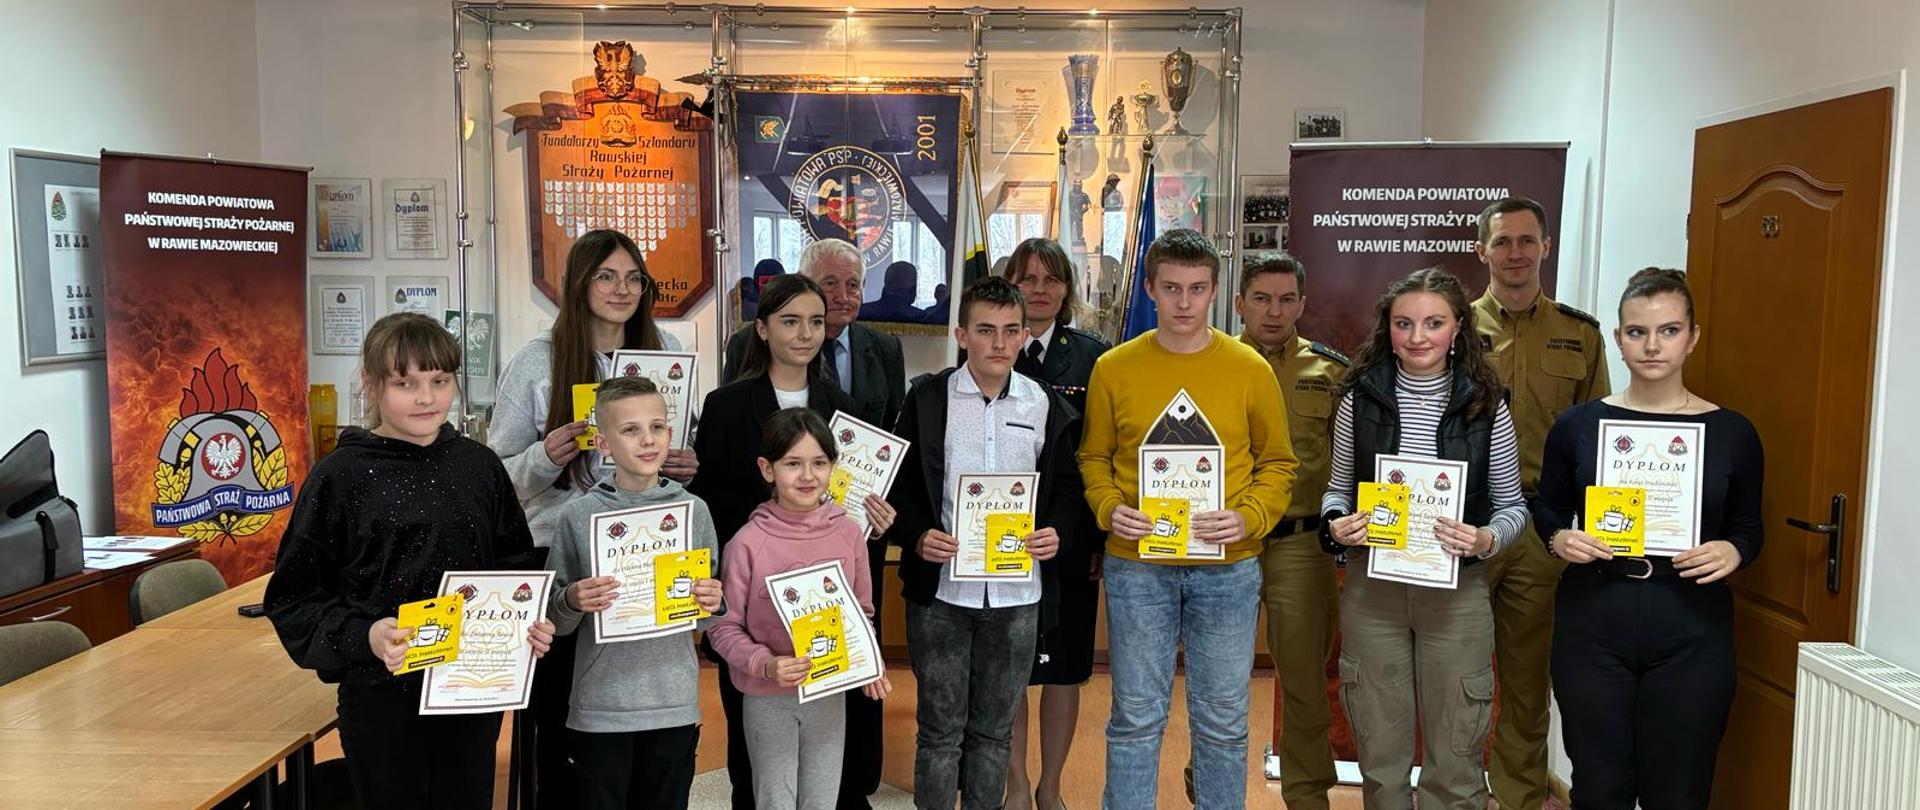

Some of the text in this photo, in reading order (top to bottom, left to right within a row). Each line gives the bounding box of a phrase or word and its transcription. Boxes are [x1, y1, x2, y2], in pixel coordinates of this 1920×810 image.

[638, 136, 696, 149] Sztandaru
[917, 115, 936, 161] 2001
[590, 151, 647, 163] Rawskiej
[562, 165, 674, 180] Straży Pożarnej
[148, 192, 275, 210] KOMENDA POWIATOWA
[1342, 187, 1509, 201] KOMENDA POWIATOWA
[395, 204, 429, 214] Dyplom
[124, 212, 294, 234] PAŃSTWOWEJ STRAŻY POŻARNEJ
[1313, 211, 1409, 229] PAŃSTWOWEJ
[1411, 212, 1465, 227] STRAŻY
[148, 238, 278, 254] W RAWIE MAZOWIECKIEJ
[1338, 240, 1475, 252] W RAWIE MAZOWIE
[840, 452, 885, 477] YPLOM
[1613, 460, 1686, 472] DYPLOM
[1152, 479, 1211, 489] DYPLOM
[156, 488, 291, 523] PAŃSTWOWA STRAŻ POŻARNA
[966, 501, 1024, 510] DYPLOM
[1408, 493, 1450, 507] PLOM
[607, 537, 677, 559] DYPLOM
[465, 609, 529, 621] YPLOM
